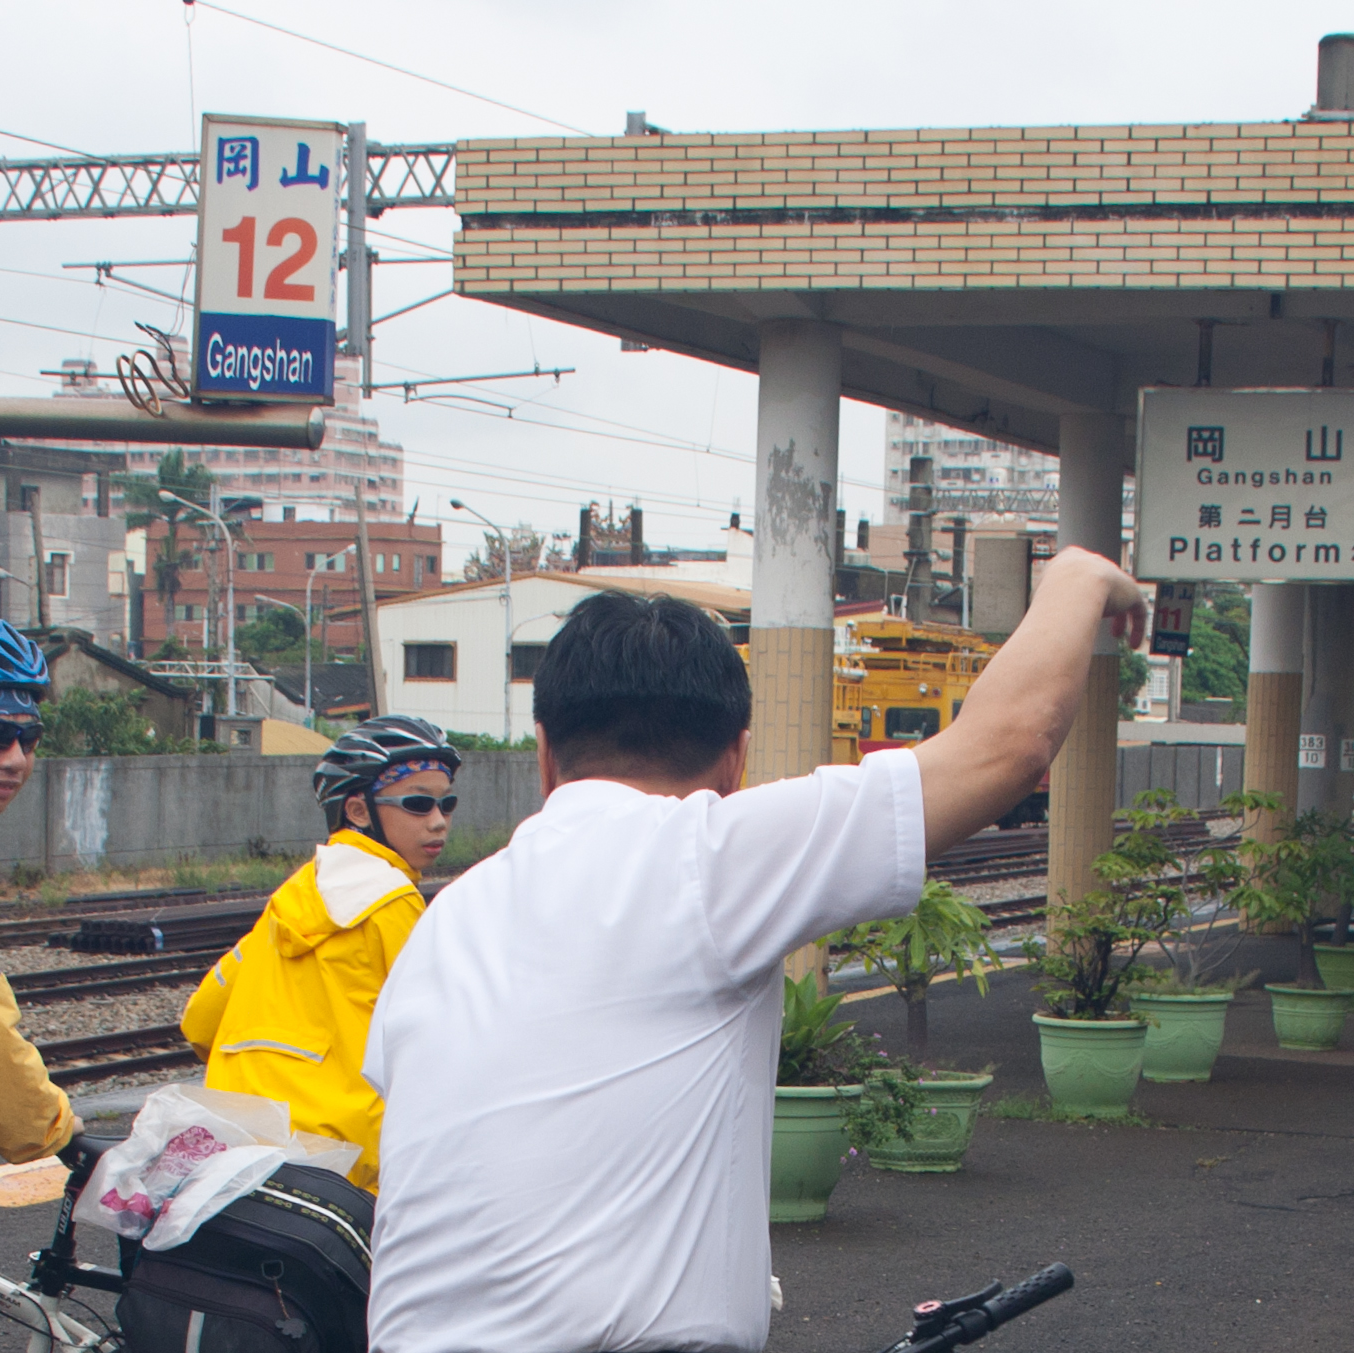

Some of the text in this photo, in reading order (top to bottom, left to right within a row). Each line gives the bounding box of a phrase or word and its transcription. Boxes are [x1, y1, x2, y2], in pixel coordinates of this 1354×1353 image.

[216, 136, 330, 191] 岡山
[222, 216, 318, 302] 12
[207, 332, 313, 391] Gangshan
[1186, 425, 1343, 463] 岡山
[1197, 467, 1332, 487] Gangshan
[1198, 504, 1327, 529] 第二月台
[1169, 537, 1340, 563] Platform
[1158, 606, 1181, 630] 11
[1301, 736, 1324, 748] 383
[1305, 752, 1318, 763] 10
